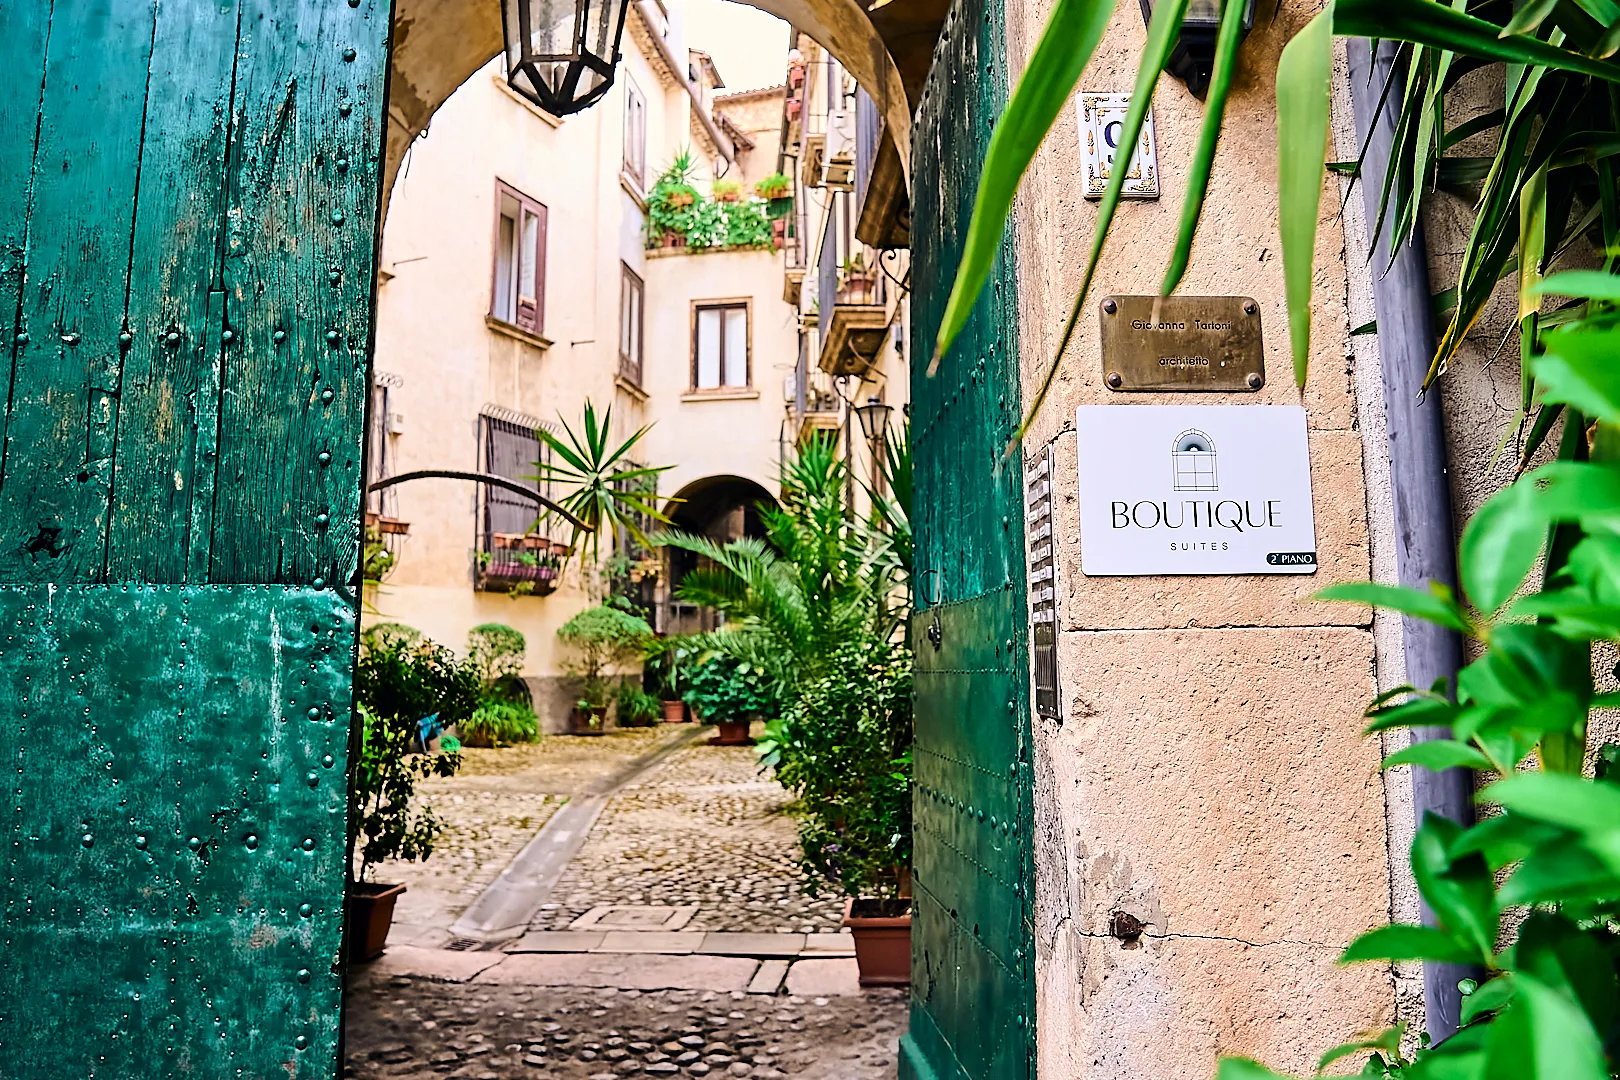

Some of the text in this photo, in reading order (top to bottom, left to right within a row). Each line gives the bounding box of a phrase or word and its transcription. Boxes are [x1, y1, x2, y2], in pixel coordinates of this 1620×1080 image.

[1131, 319, 1185, 330] Giovanna
[1158, 355, 1209, 366] architetto
[1111, 500, 1283, 533] BOUTIQUE
[1169, 541, 1229, 551] SUITES
[1281, 554, 1313, 564] PIANO
